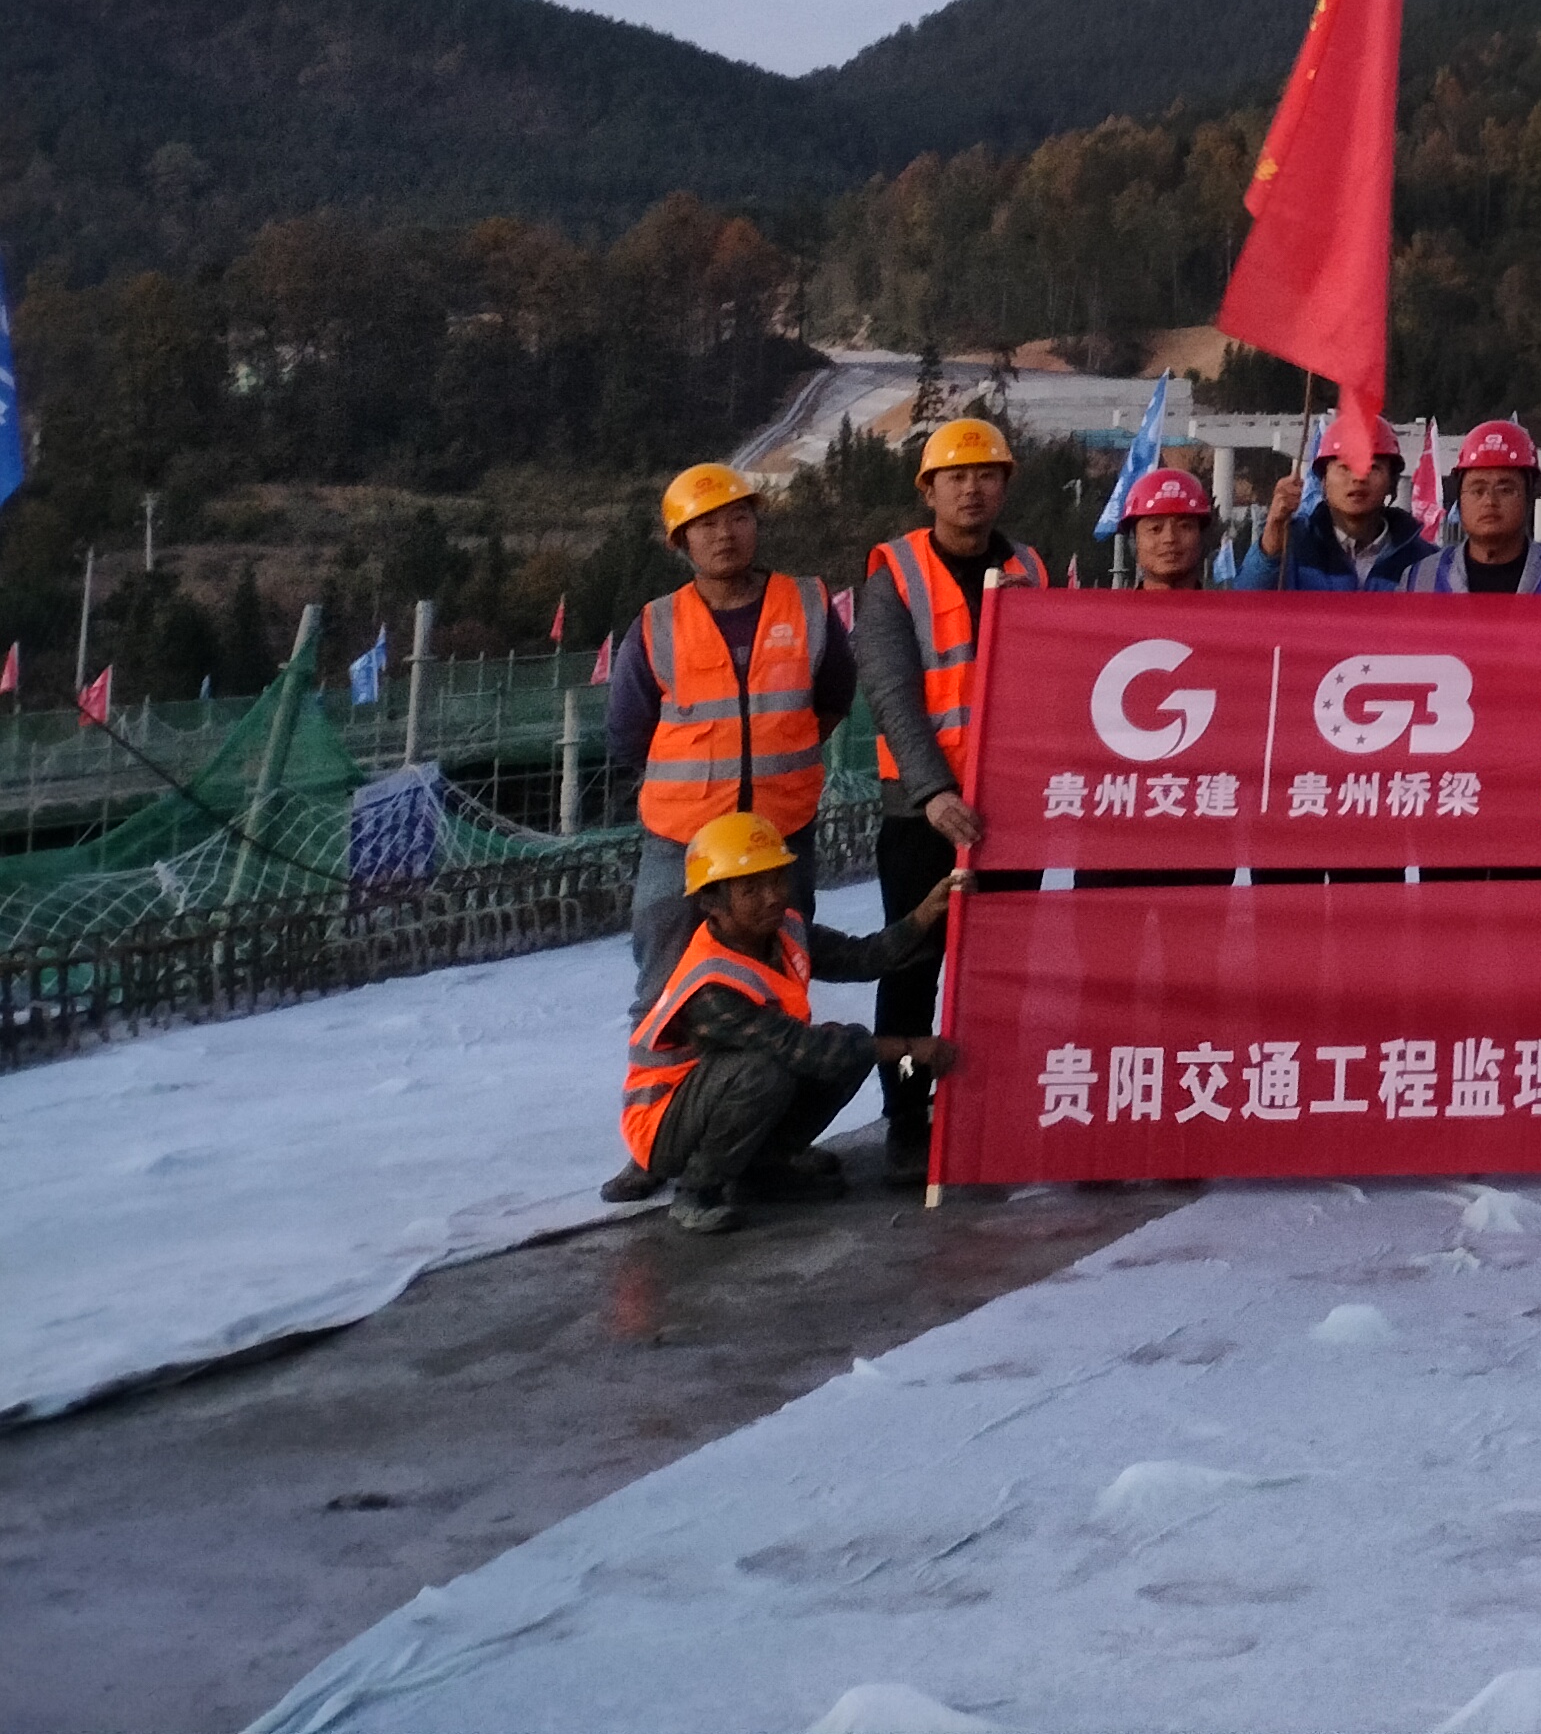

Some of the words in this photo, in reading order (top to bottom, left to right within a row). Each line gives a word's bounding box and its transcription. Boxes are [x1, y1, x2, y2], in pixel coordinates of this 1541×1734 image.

[1042, 771, 1240, 820] 贵州交建
[1287, 770, 1482, 819] 贵州桥梁
